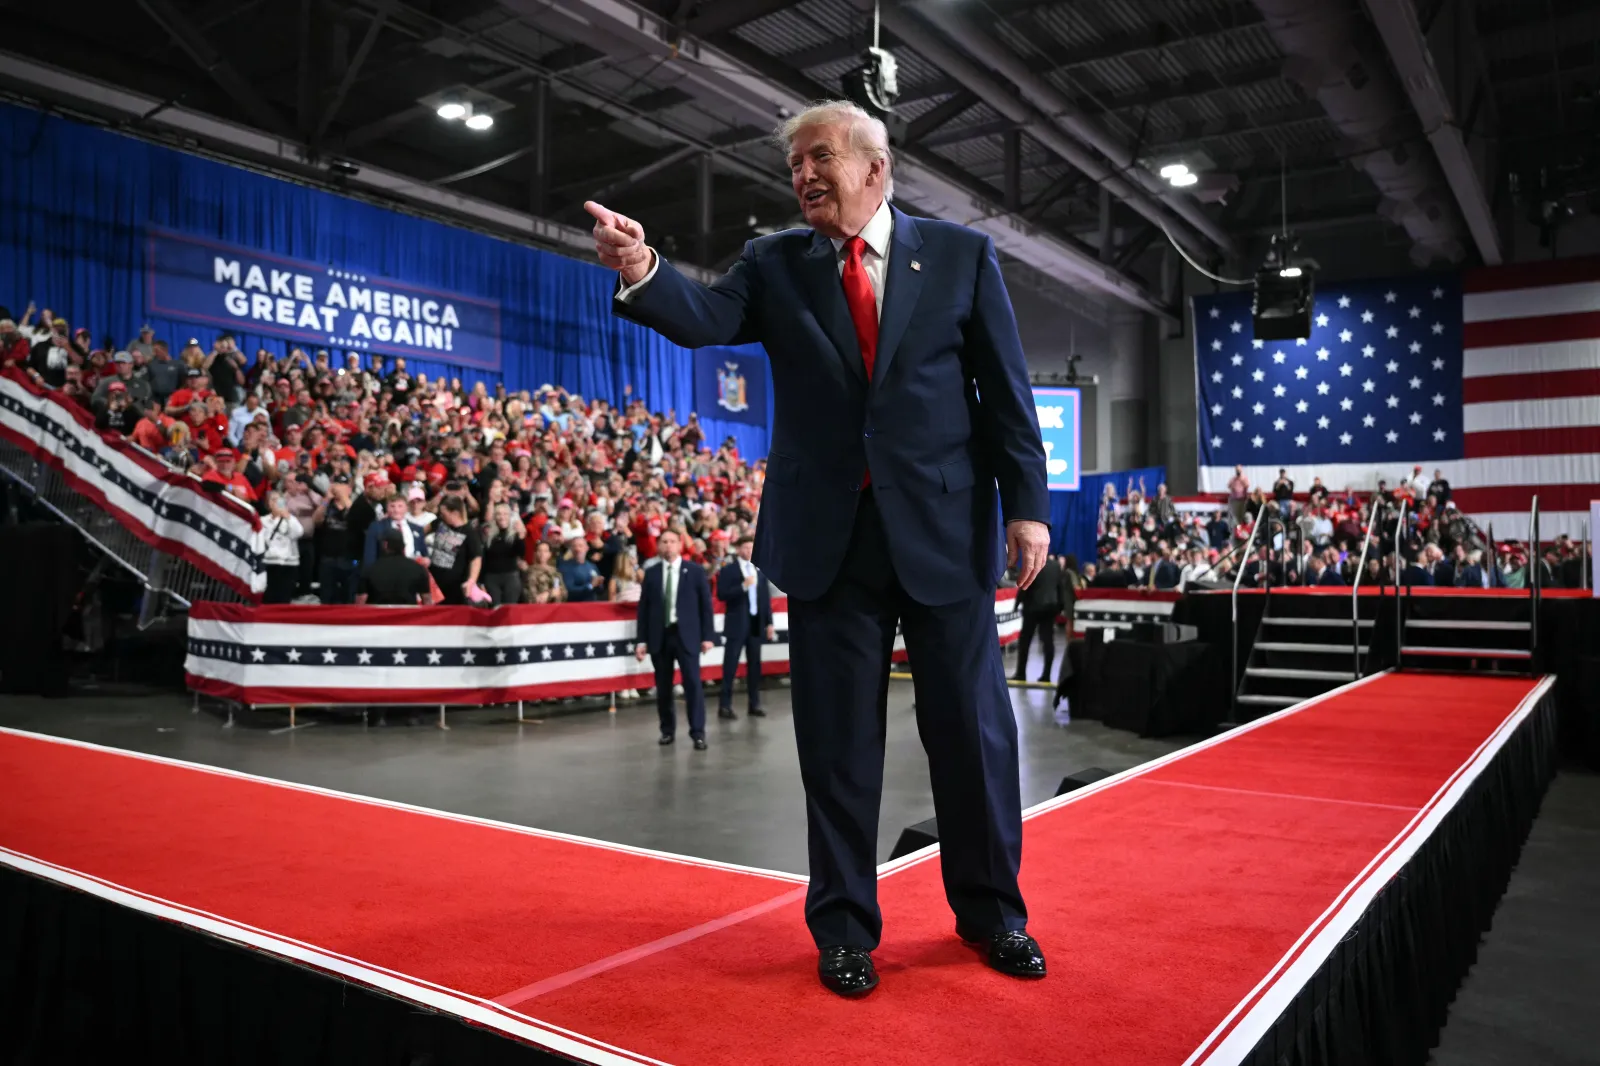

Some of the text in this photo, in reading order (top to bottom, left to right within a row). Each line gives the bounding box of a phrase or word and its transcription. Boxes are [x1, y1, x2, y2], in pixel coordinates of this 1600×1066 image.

[213, 257, 460, 329] MAKE AMERICA
[223, 289, 454, 353] GREAT AGAIN!
